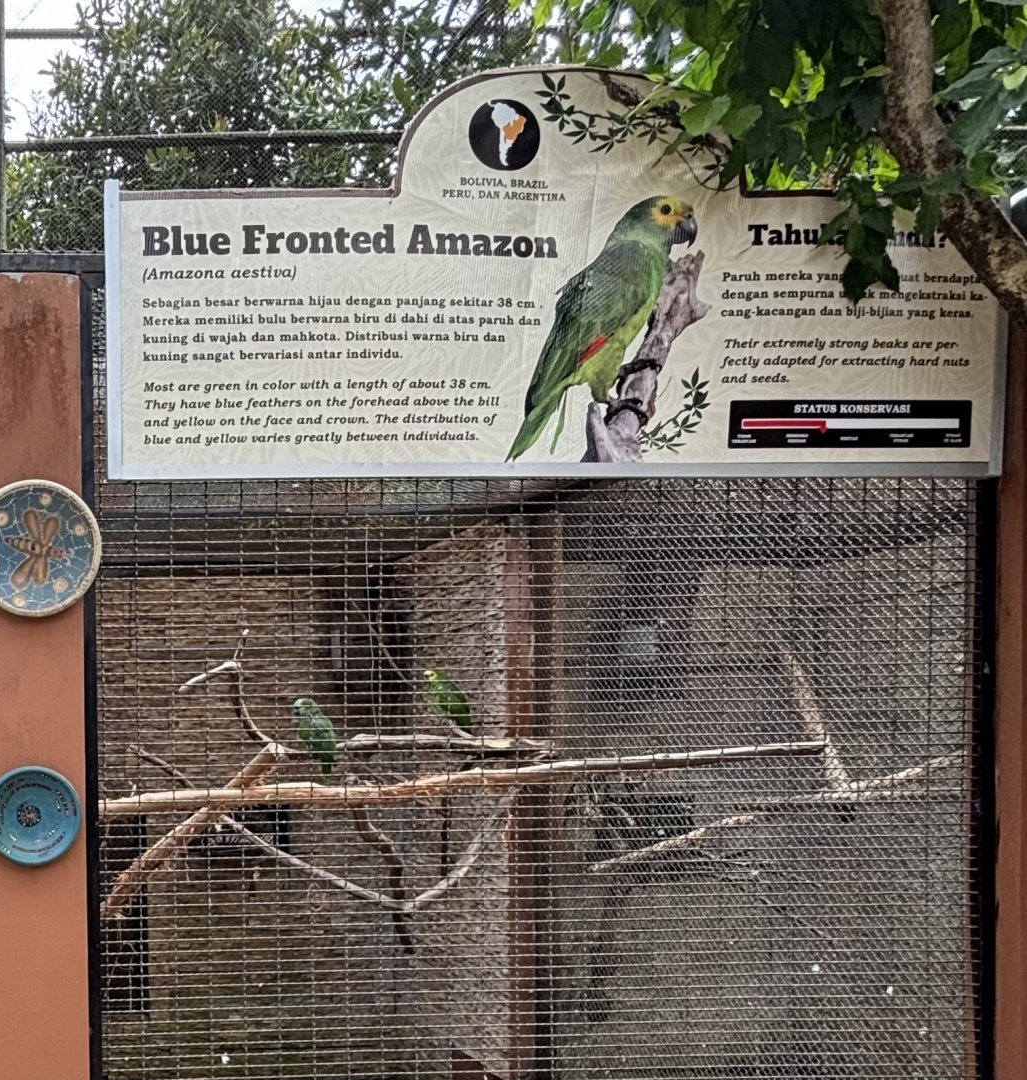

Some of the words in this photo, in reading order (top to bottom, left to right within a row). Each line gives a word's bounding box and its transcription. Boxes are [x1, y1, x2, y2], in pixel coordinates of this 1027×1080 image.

[459, 176, 507, 188] BOLIVIA,
[510, 178, 548, 189] BRAZIL
[442, 188, 474, 200] PERU,
[478, 190, 500, 199] DAN
[503, 191, 565, 201] ARGENTINA
[142, 225, 230, 256] Blue
[242, 223, 395, 254] Fronted
[406, 224, 558, 258] Amazon
[142, 267, 225, 283] (Amazona
[230, 265, 296, 281] aestiva)
[722, 270, 760, 282] Paruh
[765, 269, 813, 281] mereka
[721, 289, 768, 301] dengan
[772, 290, 834, 301] sempurna
[878, 287, 966, 302] mengekstraksi
[969, 290, 987, 301] ka-
[720, 305, 815, 319] cang-kacangan
[819, 305, 842, 316] dan
[845, 304, 903, 319] biji-bijian
[906, 309, 935, 320] yang
[939, 307, 973, 318] keras.
[142, 333, 188, 346] kuning
[192, 332, 205, 342] di
[208, 331, 246, 345] wajah
[251, 331, 274, 342] dan
[279, 331, 340, 341] mahkota.
[345, 330, 408, 341] Distribusi
[411, 333, 449, 341] warna
[453, 330, 478, 341] biru
[483, 331, 505, 342] dan
[723, 337, 760, 349] Their
[762, 337, 826, 351] extremely
[828, 338, 869, 351] strong
[871, 338, 908, 348] beaks
[934, 341, 959, 351] per-
[142, 351, 188, 363] kuning
[192, 350, 235, 363] sangat
[239, 348, 303, 360] bervariasi
[307, 349, 342, 359] antar
[346, 348, 403, 359] individu.
[720, 355, 760, 369] fectly
[762, 354, 815, 368] adapted
[818, 355, 839, 369] for
[841, 355, 905, 368] extracting
[908, 355, 940, 366] hard
[942, 357, 969, 366] nuts
[721, 373, 747, 383] and
[750, 372, 789, 383] seeds.
[143, 381, 174, 392] Most
[178, 383, 200, 391] are
[203, 383, 240, 394] green
[245, 380, 258, 390] in
[262, 379, 296, 390] color
[300, 379, 329, 389] with
[333, 381, 342, 389] a
[347, 378, 388, 392] length
[392, 378, 407, 391] of
[408, 378, 445, 388] about
[449, 378, 466, 389] 38
[469, 381, 491, 389] cm.
[794, 404, 837, 413] STATUS
[839, 404, 910, 413] KONSERVASI
[143, 434, 171, 444] blue
[175, 433, 201, 444] and
[204, 433, 247, 446] yellow
[251, 432, 291, 443] varies
[294, 431, 342, 445] greatly
[345, 431, 398, 441] between
[403, 430, 478, 441] individuals.
